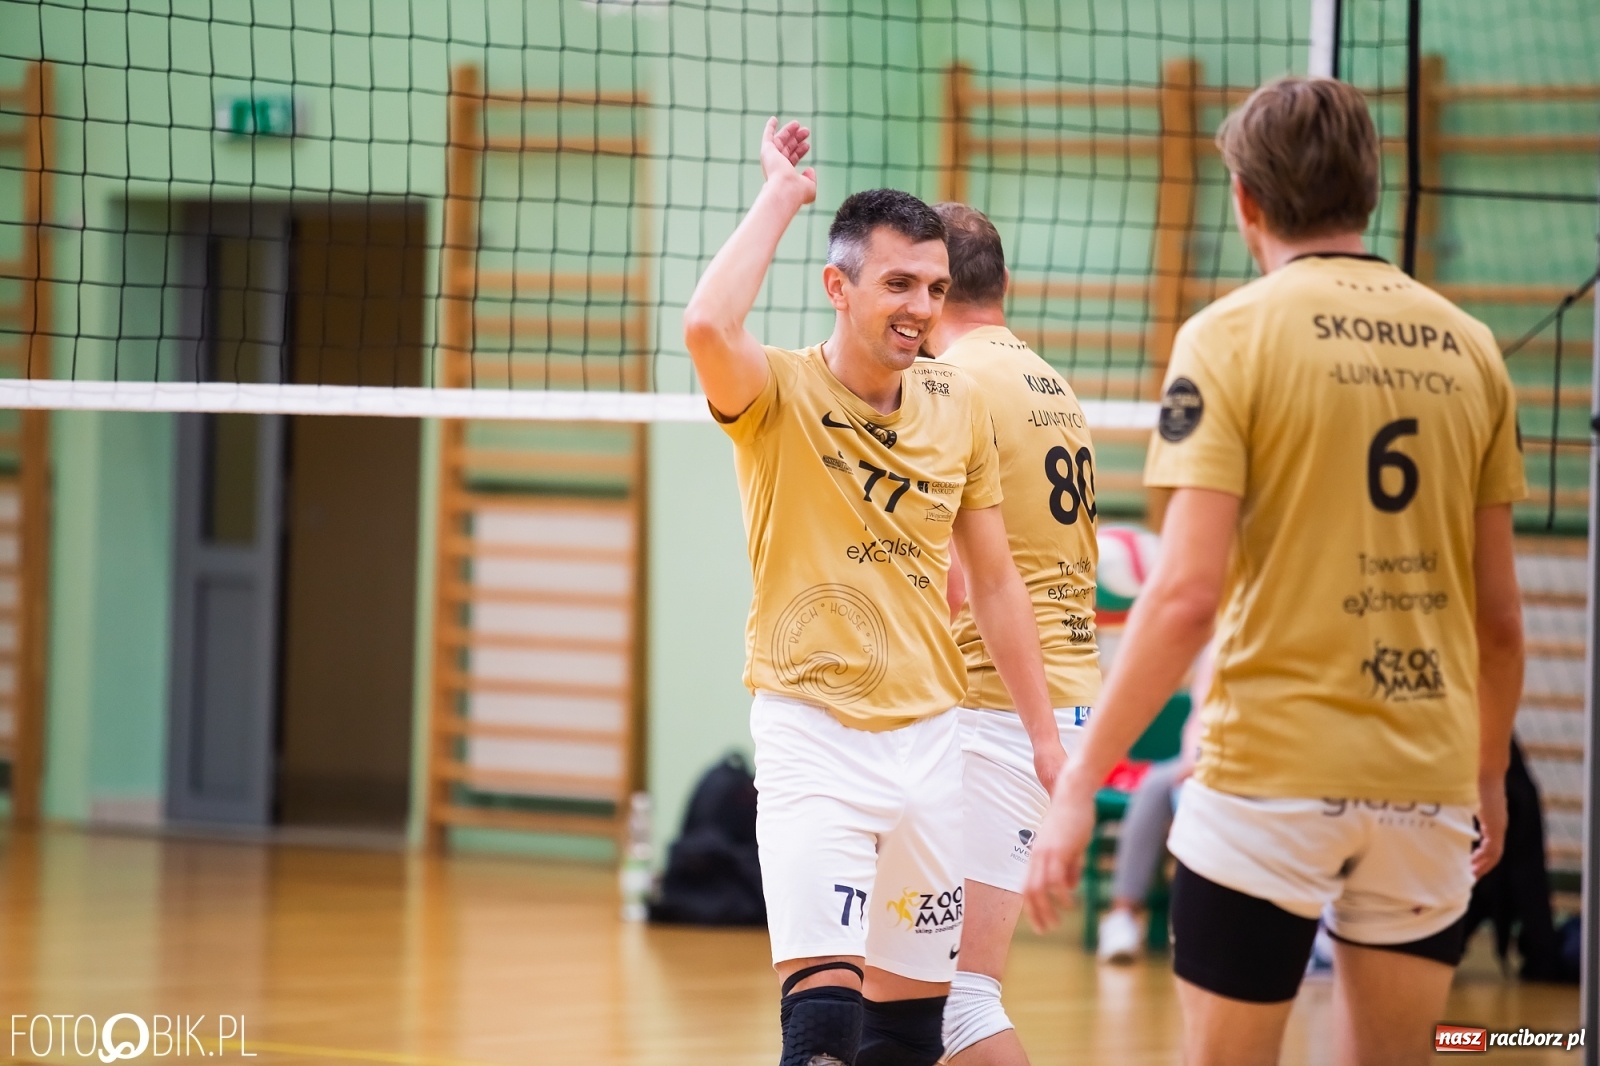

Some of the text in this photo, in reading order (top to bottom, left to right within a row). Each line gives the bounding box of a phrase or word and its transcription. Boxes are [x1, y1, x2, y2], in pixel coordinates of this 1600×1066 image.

[1313, 314, 1462, 355] SKORUPA
[1023, 373, 1067, 396] KUBA
[1329, 363, 1463, 396] -LUNATYCY-
[1044, 445, 1098, 526] 80
[1366, 417, 1419, 513] 6
[858, 459, 912, 514] 77
[789, 606, 819, 645] BEACH
[830, 602, 868, 632] HOUSE
[834, 884, 867, 930] 77
[915, 903, 963, 927] MAR
[919, 886, 963, 911] ZOO
